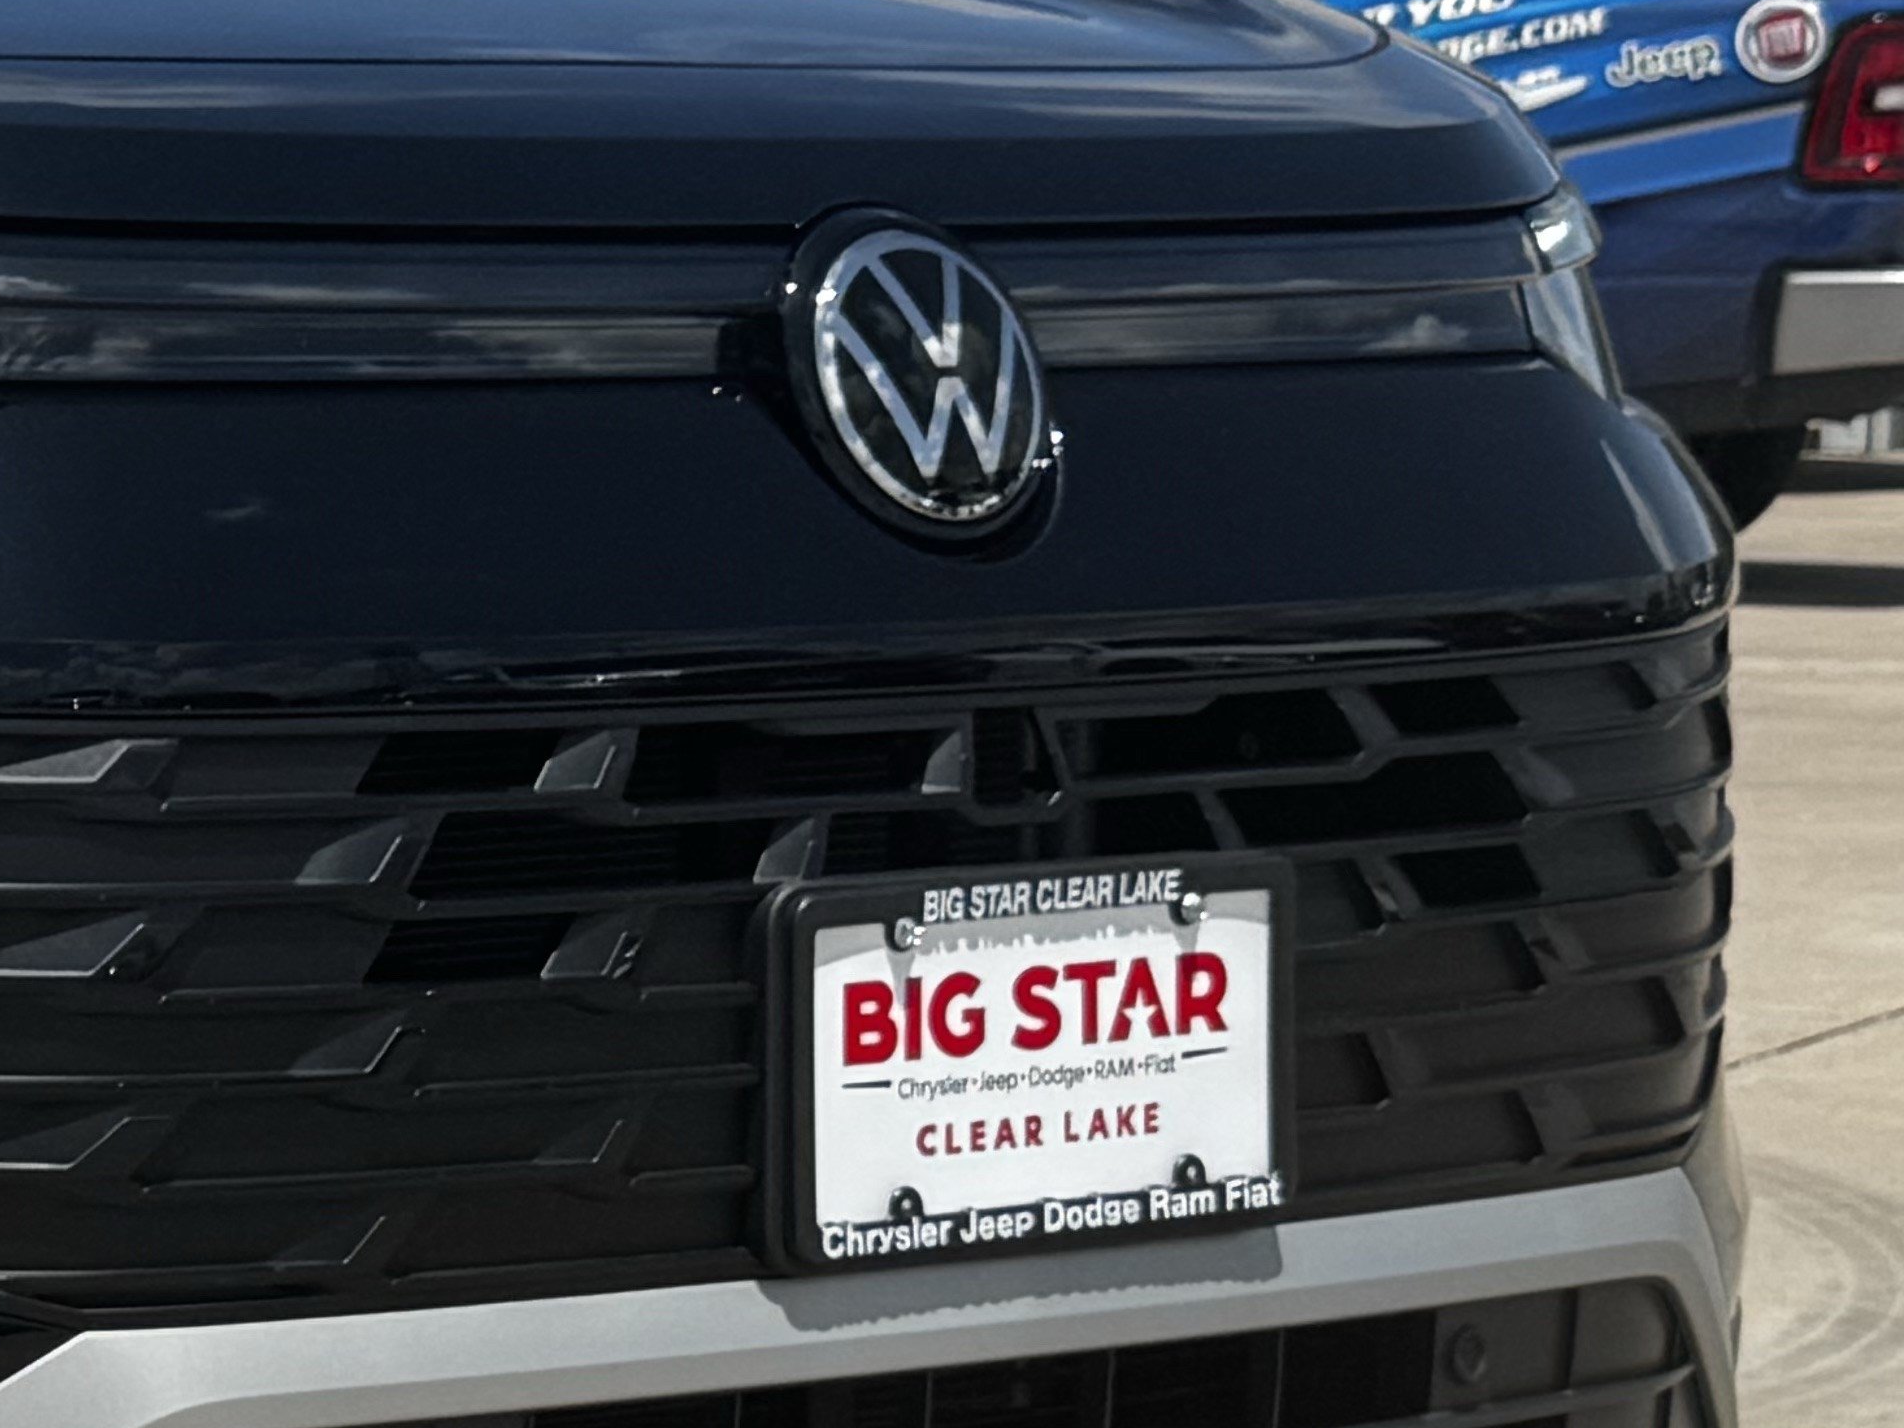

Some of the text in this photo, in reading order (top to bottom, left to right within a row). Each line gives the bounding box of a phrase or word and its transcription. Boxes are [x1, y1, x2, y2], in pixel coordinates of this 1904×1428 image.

[1605, 35, 1723, 89] Jeep
[923, 869, 1183, 923] BIG STAR CLEAR LAKE
[842, 951, 1229, 1066] BIG STAR
[915, 1102, 1161, 1157] CLEAR LAKE
[822, 1172, 1283, 1259] Chrysler Jeep Dodge Ram Fiat
